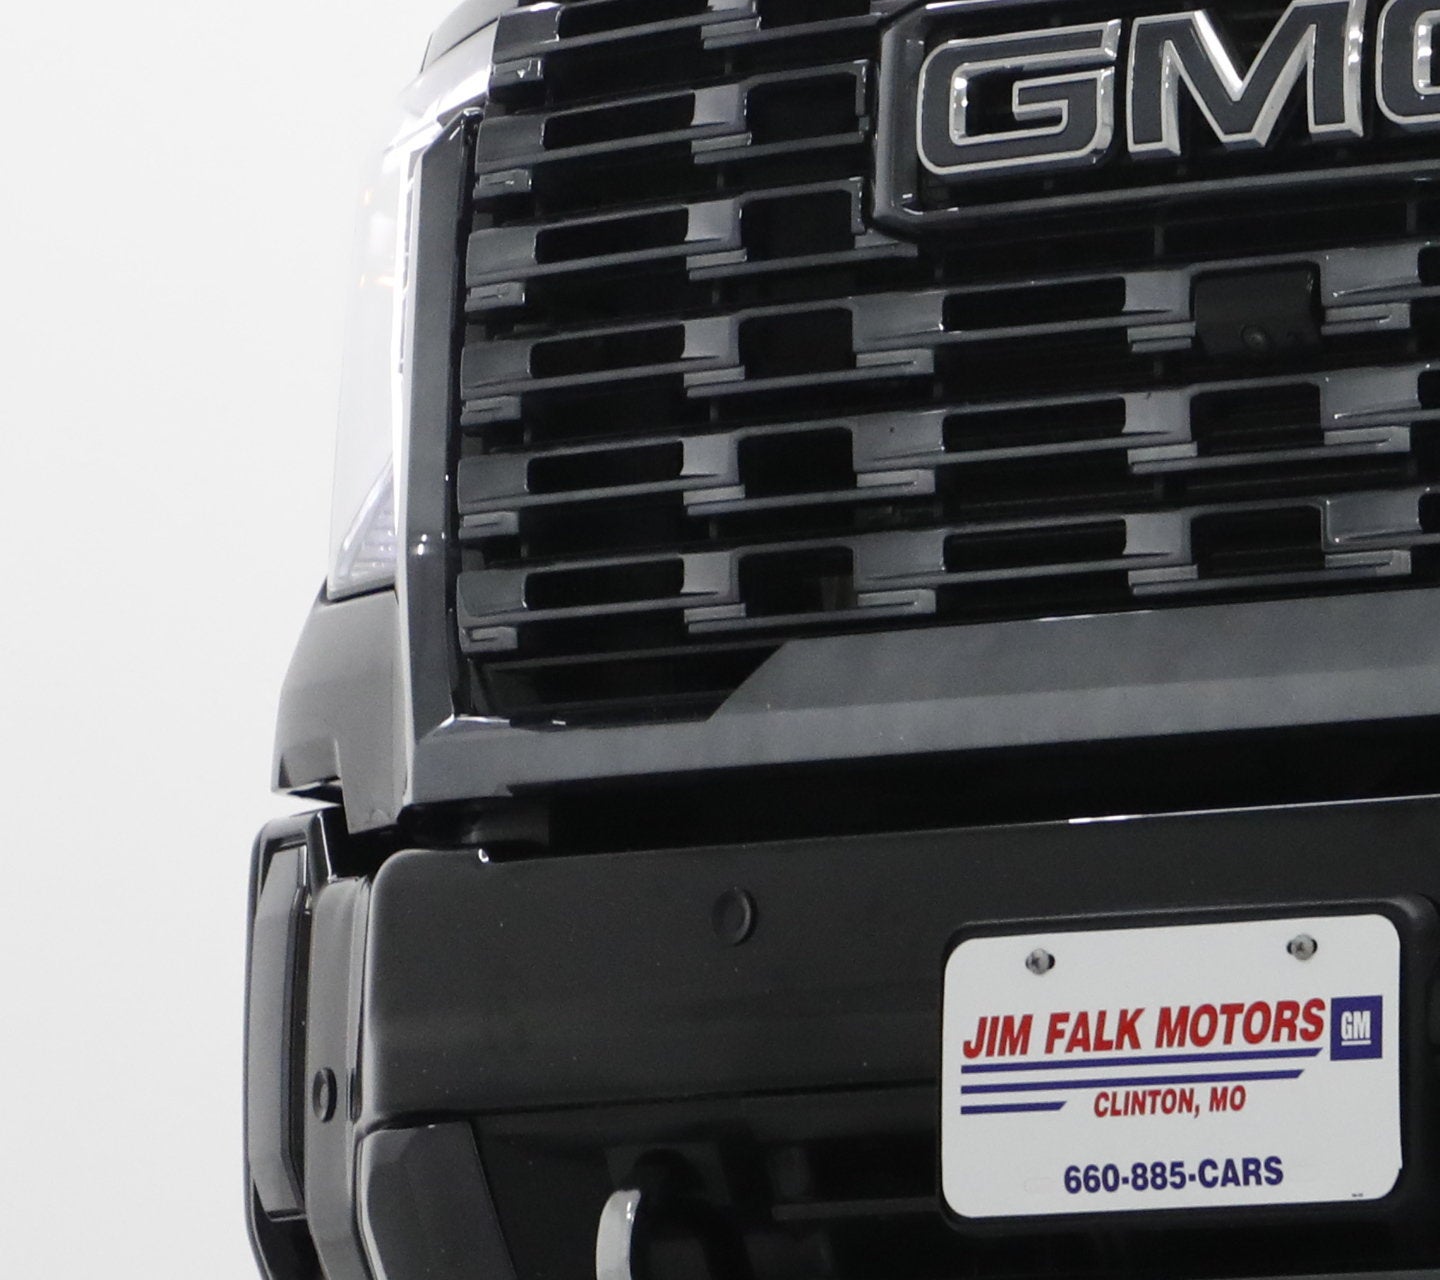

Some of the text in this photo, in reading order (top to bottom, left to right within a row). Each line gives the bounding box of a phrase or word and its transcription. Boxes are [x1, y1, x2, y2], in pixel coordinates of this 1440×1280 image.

[962, 998, 1326, 1059] JIM FALK MOTORS
[1340, 1009, 1372, 1046] GM
[1093, 1085, 1247, 1119] CLINTON, MO
[1063, 1156, 1284, 1195] 660-885-CARS
